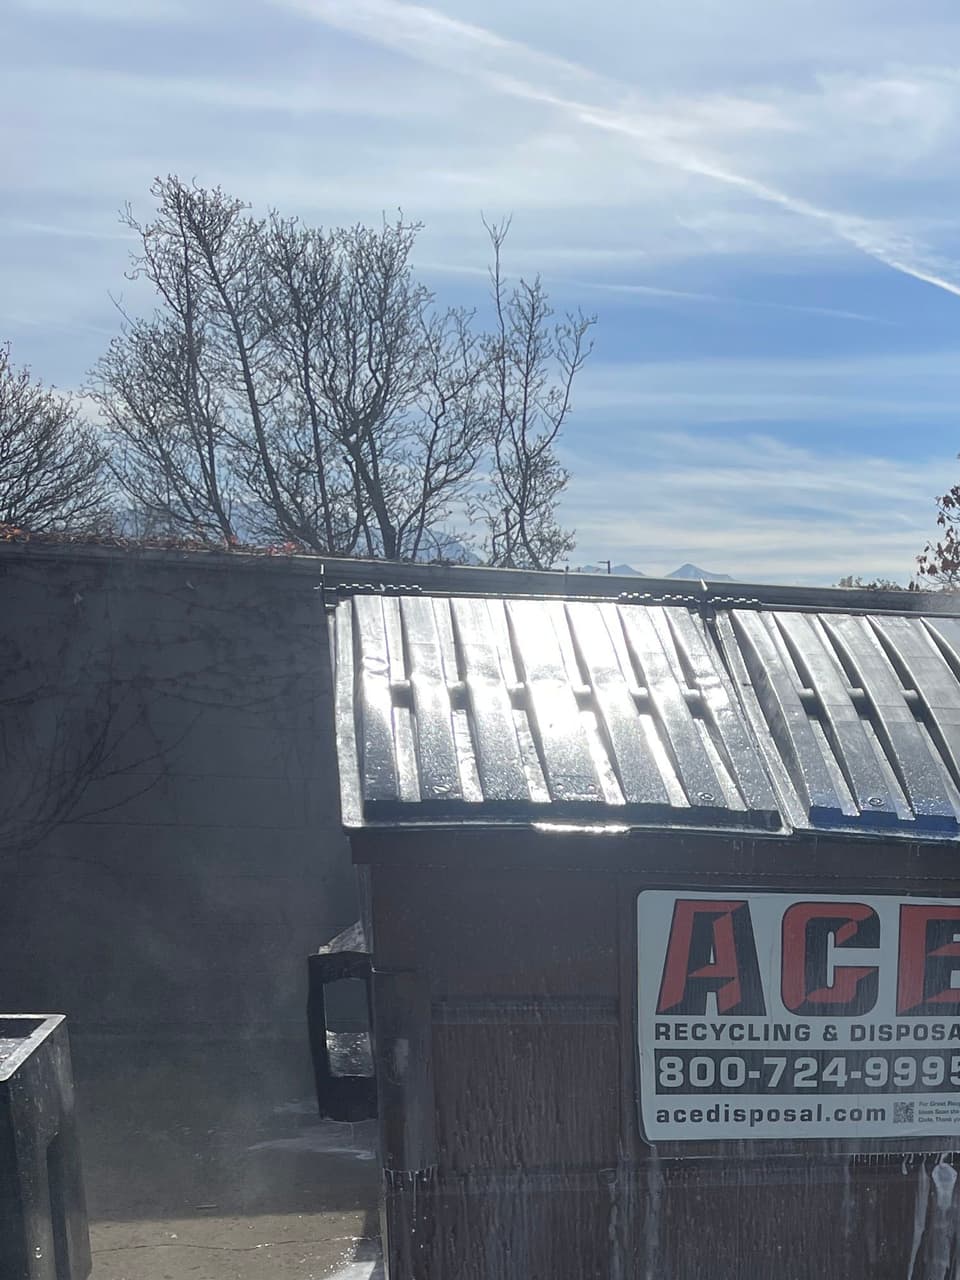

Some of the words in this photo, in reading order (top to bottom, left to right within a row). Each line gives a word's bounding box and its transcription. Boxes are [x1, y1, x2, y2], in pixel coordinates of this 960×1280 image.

[655, 1022, 811, 1042] RECYCLING
[822, 1024, 838, 1042] &
[656, 1103, 886, 1127] acedisposal.com
